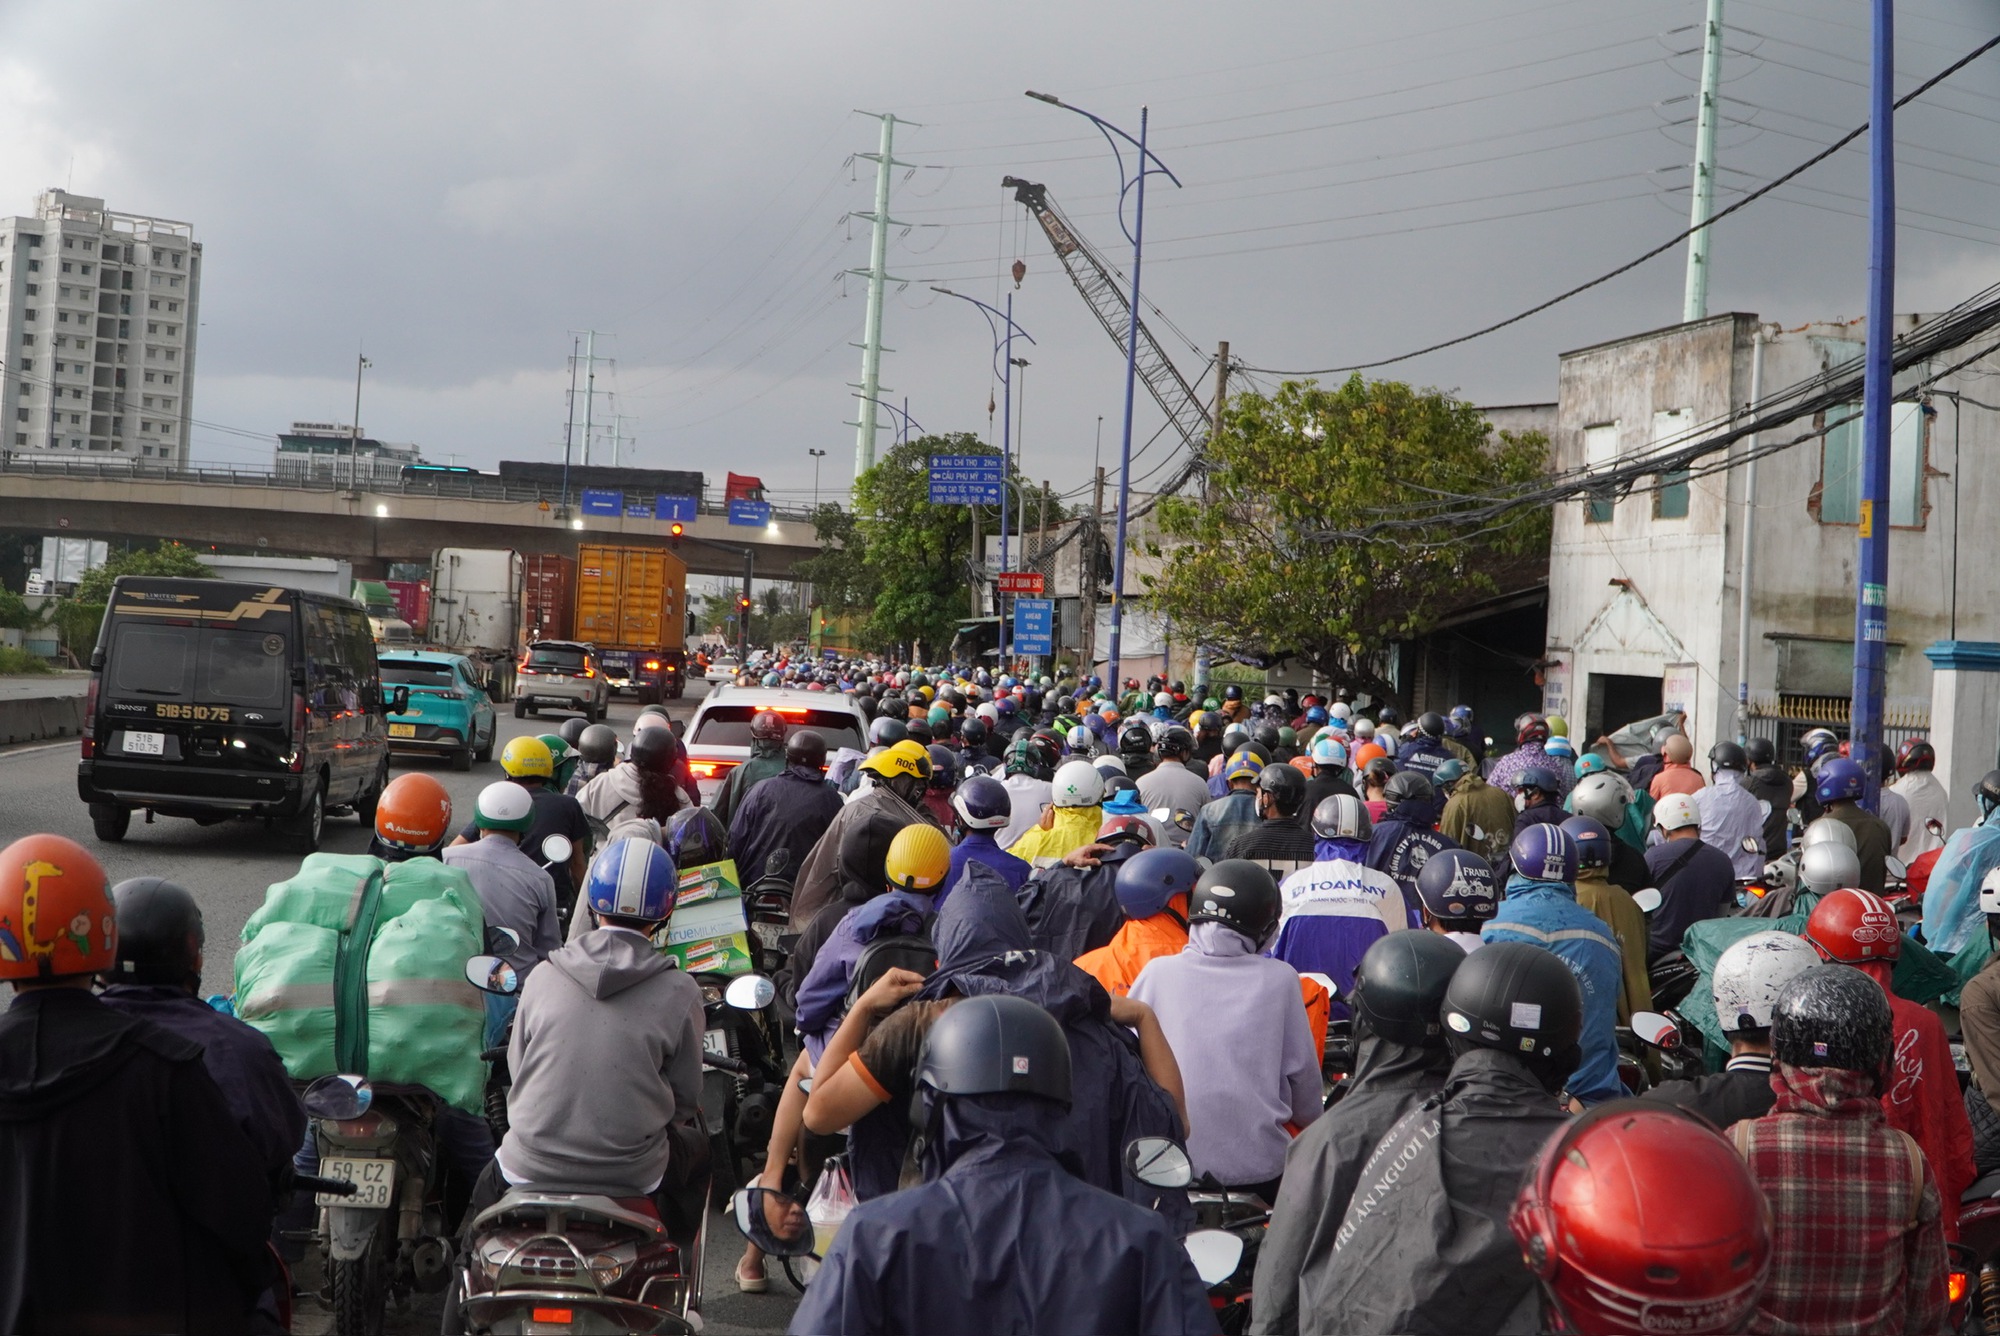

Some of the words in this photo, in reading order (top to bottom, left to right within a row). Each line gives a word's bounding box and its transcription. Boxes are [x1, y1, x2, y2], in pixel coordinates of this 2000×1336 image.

[966, 459, 978, 468] THỌ
[983, 459, 998, 467] 2Km
[983, 473, 998, 481] 3Km
[1000, 575, 1009, 587] CHÚ
[1016, 578, 1030, 588] QUAN
[1032, 576, 1042, 588] SÁT
[145, 592, 177, 600] LIMITED
[1023, 643, 1042, 651] WORKS
[114, 703, 148, 713] TRANSIT
[135, 733, 154, 743] 51B
[127, 740, 160, 753] 510.75
[894, 756, 917, 772] ROC
[395, 825, 430, 836] Ahamove
[1463, 866, 1491, 879] FRANCE
[331, 1161, 385, 1183] 59-C2
[1333, 1220, 1358, 1254] TRI
